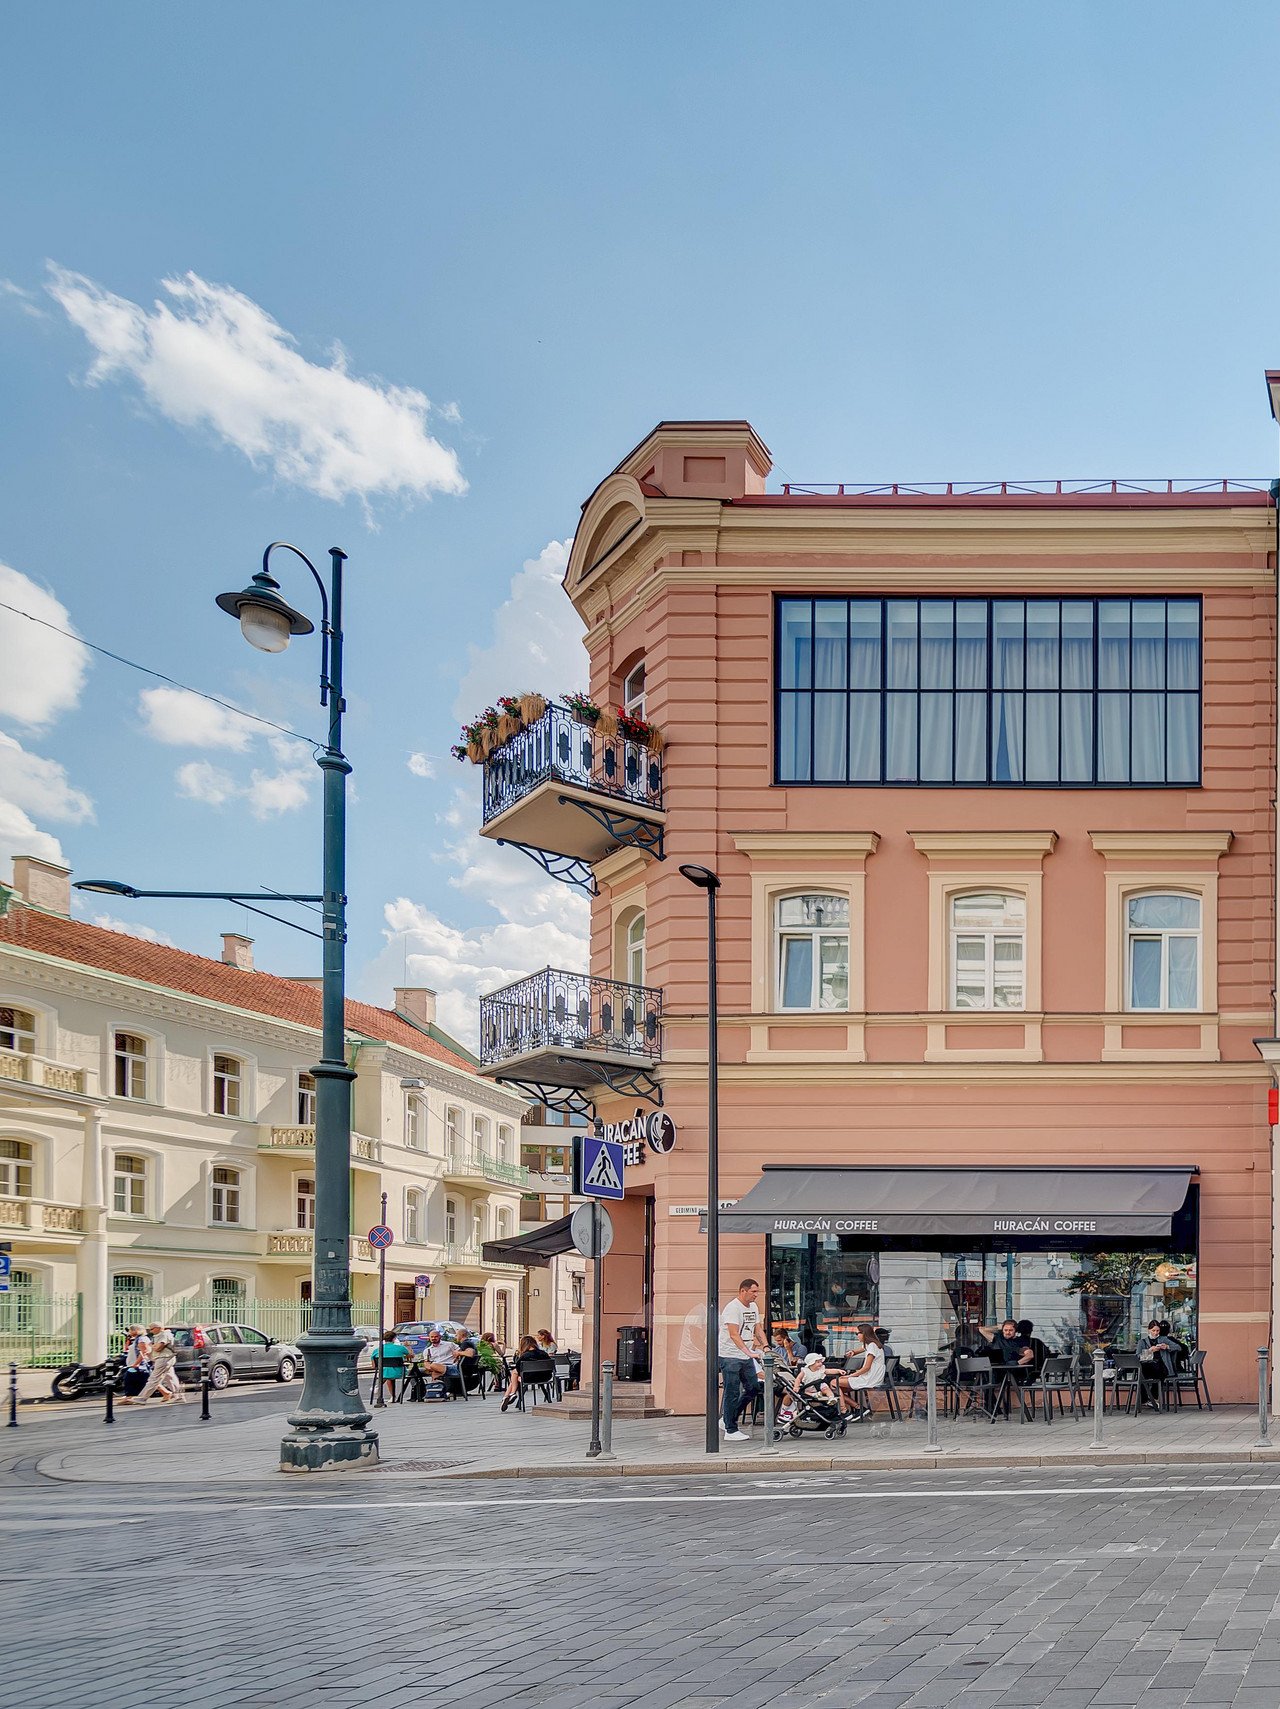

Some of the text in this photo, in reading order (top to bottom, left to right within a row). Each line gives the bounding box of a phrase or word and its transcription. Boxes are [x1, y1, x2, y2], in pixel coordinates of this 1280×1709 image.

[774, 1216, 878, 1230] HURACÁN COFFEE
[993, 1217, 1097, 1231] HURACÁN COFFEE
